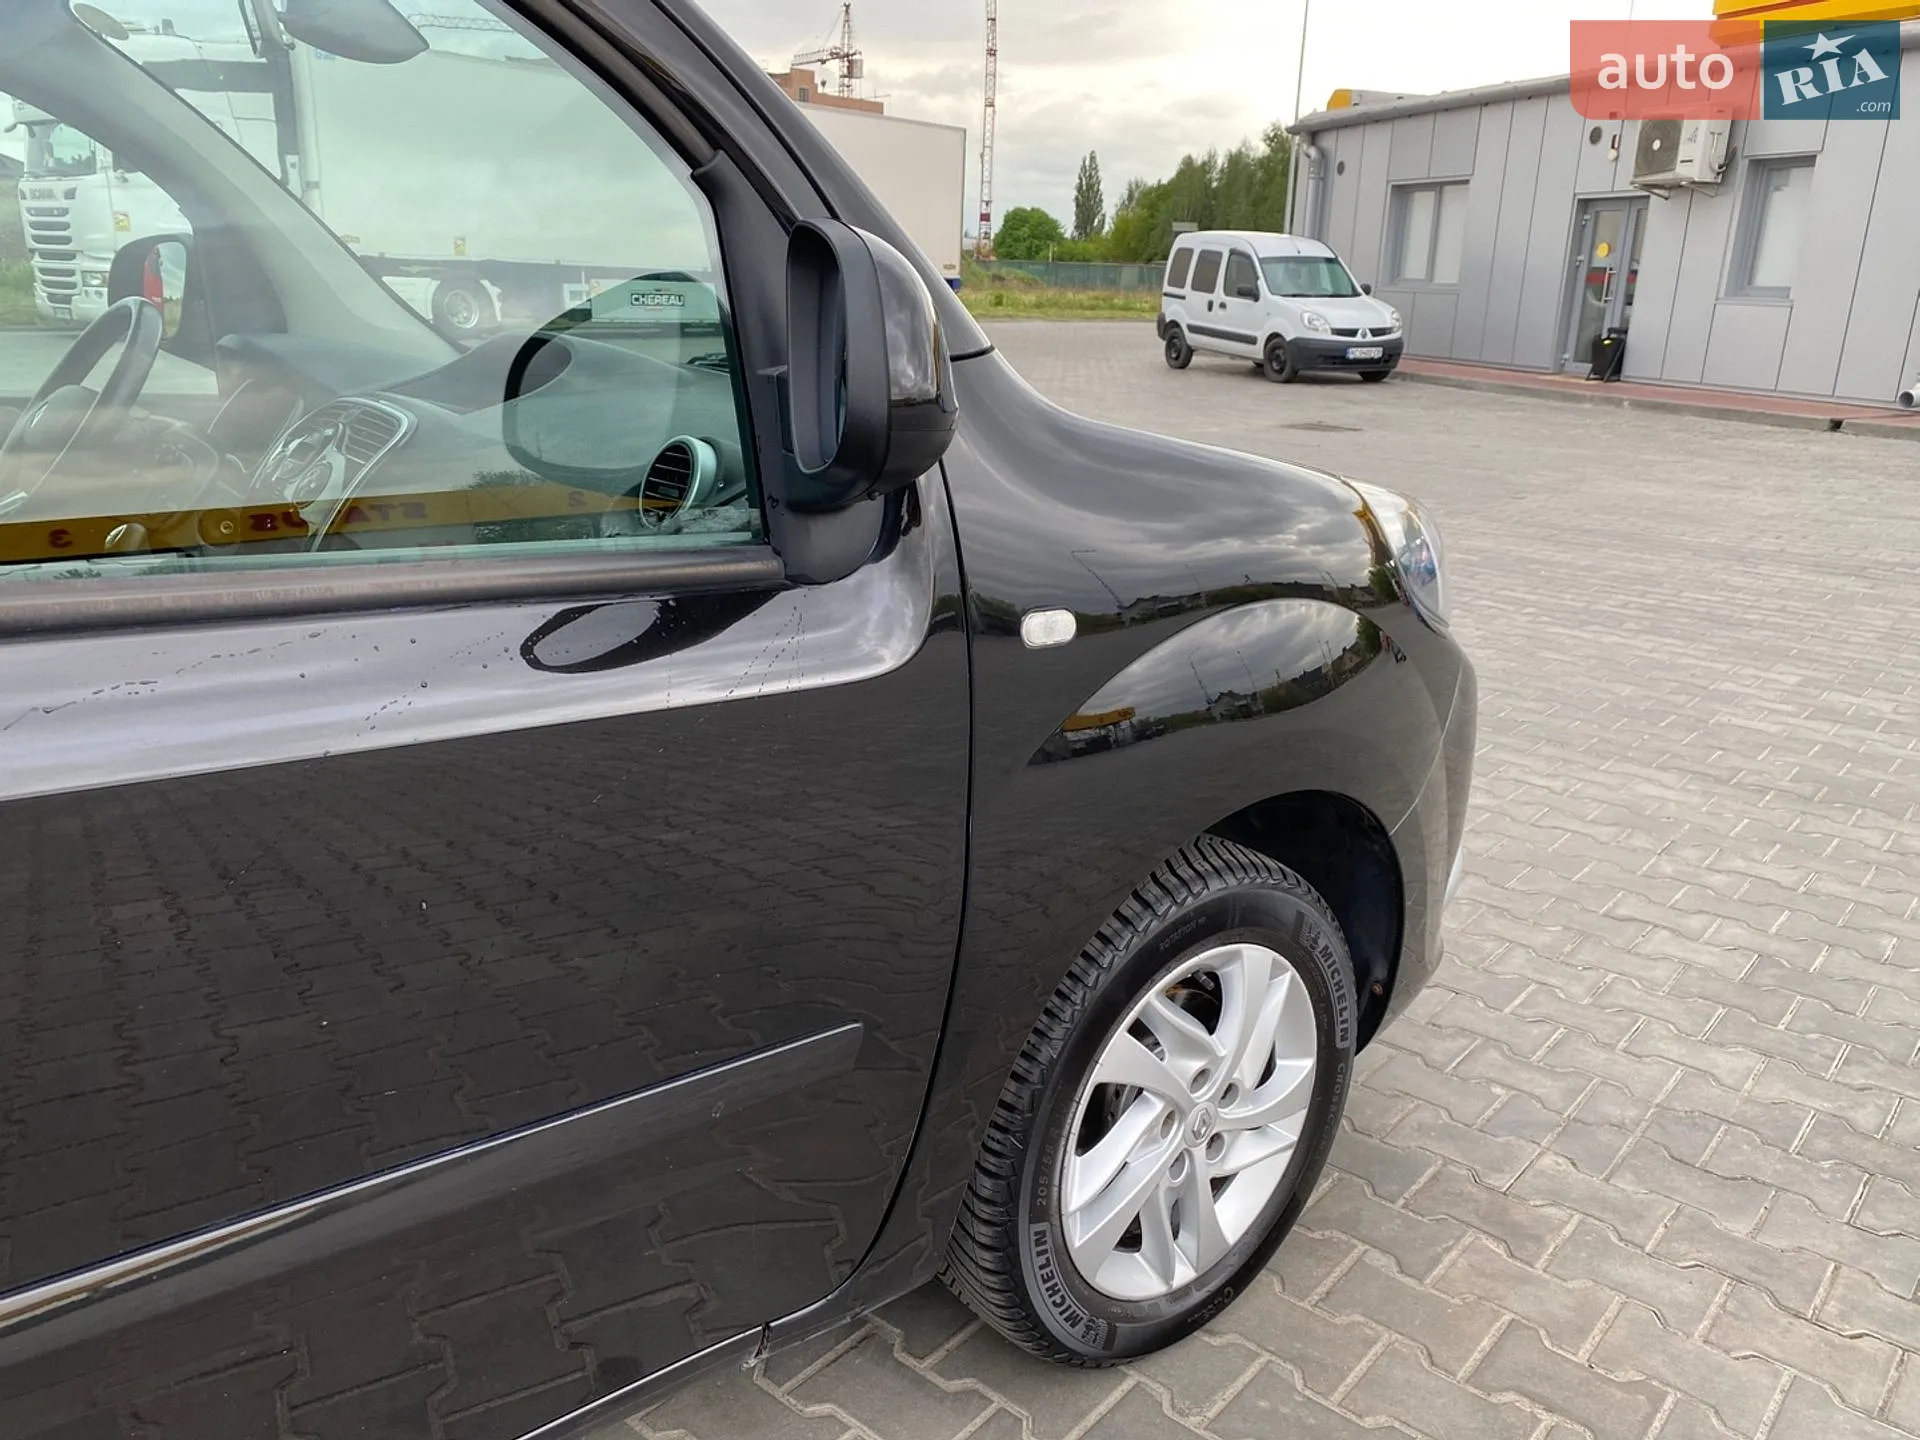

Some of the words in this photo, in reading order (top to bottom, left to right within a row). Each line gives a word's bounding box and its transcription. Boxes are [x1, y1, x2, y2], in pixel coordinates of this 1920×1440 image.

[632, 294, 684, 306] CHEREAU
[1318, 943, 1350, 1043] MICHELIN
[1033, 1229, 1085, 1329] MICHELIN
